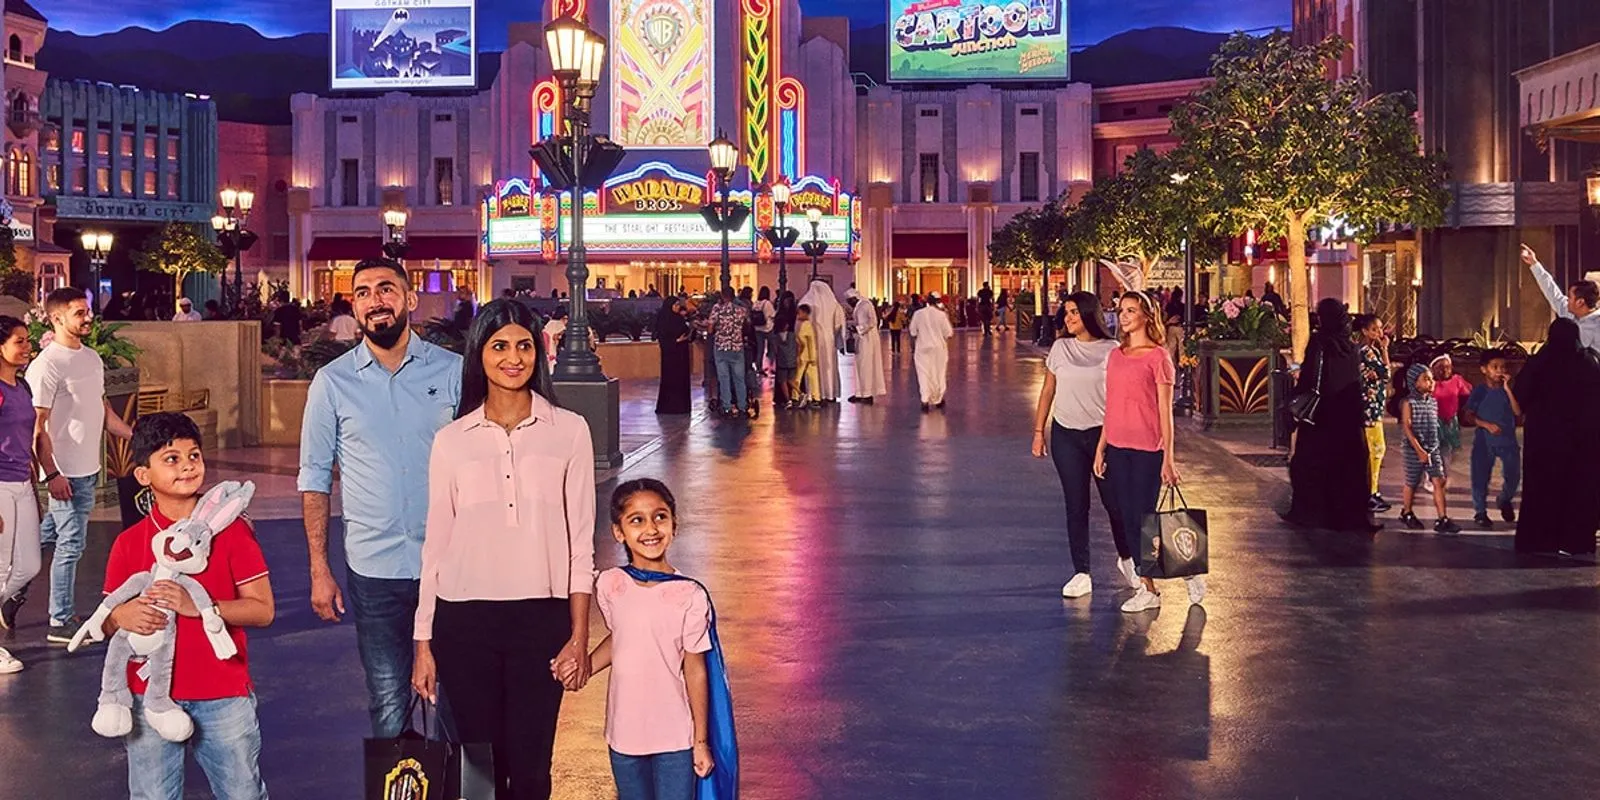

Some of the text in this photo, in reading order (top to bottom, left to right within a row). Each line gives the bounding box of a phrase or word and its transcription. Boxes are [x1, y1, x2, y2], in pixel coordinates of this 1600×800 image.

[647, 18, 675, 46] WB
[895, 0, 1058, 48] CARTOON
[951, 38, 1016, 56] JUNCTION
[612, 179, 702, 205] WARNER
[85, 201, 194, 217] GOTHAM CITY
[635, 198, 683, 211] BROS.
[604, 223, 618, 233] THE
[622, 223, 659, 233] STARLGHT
